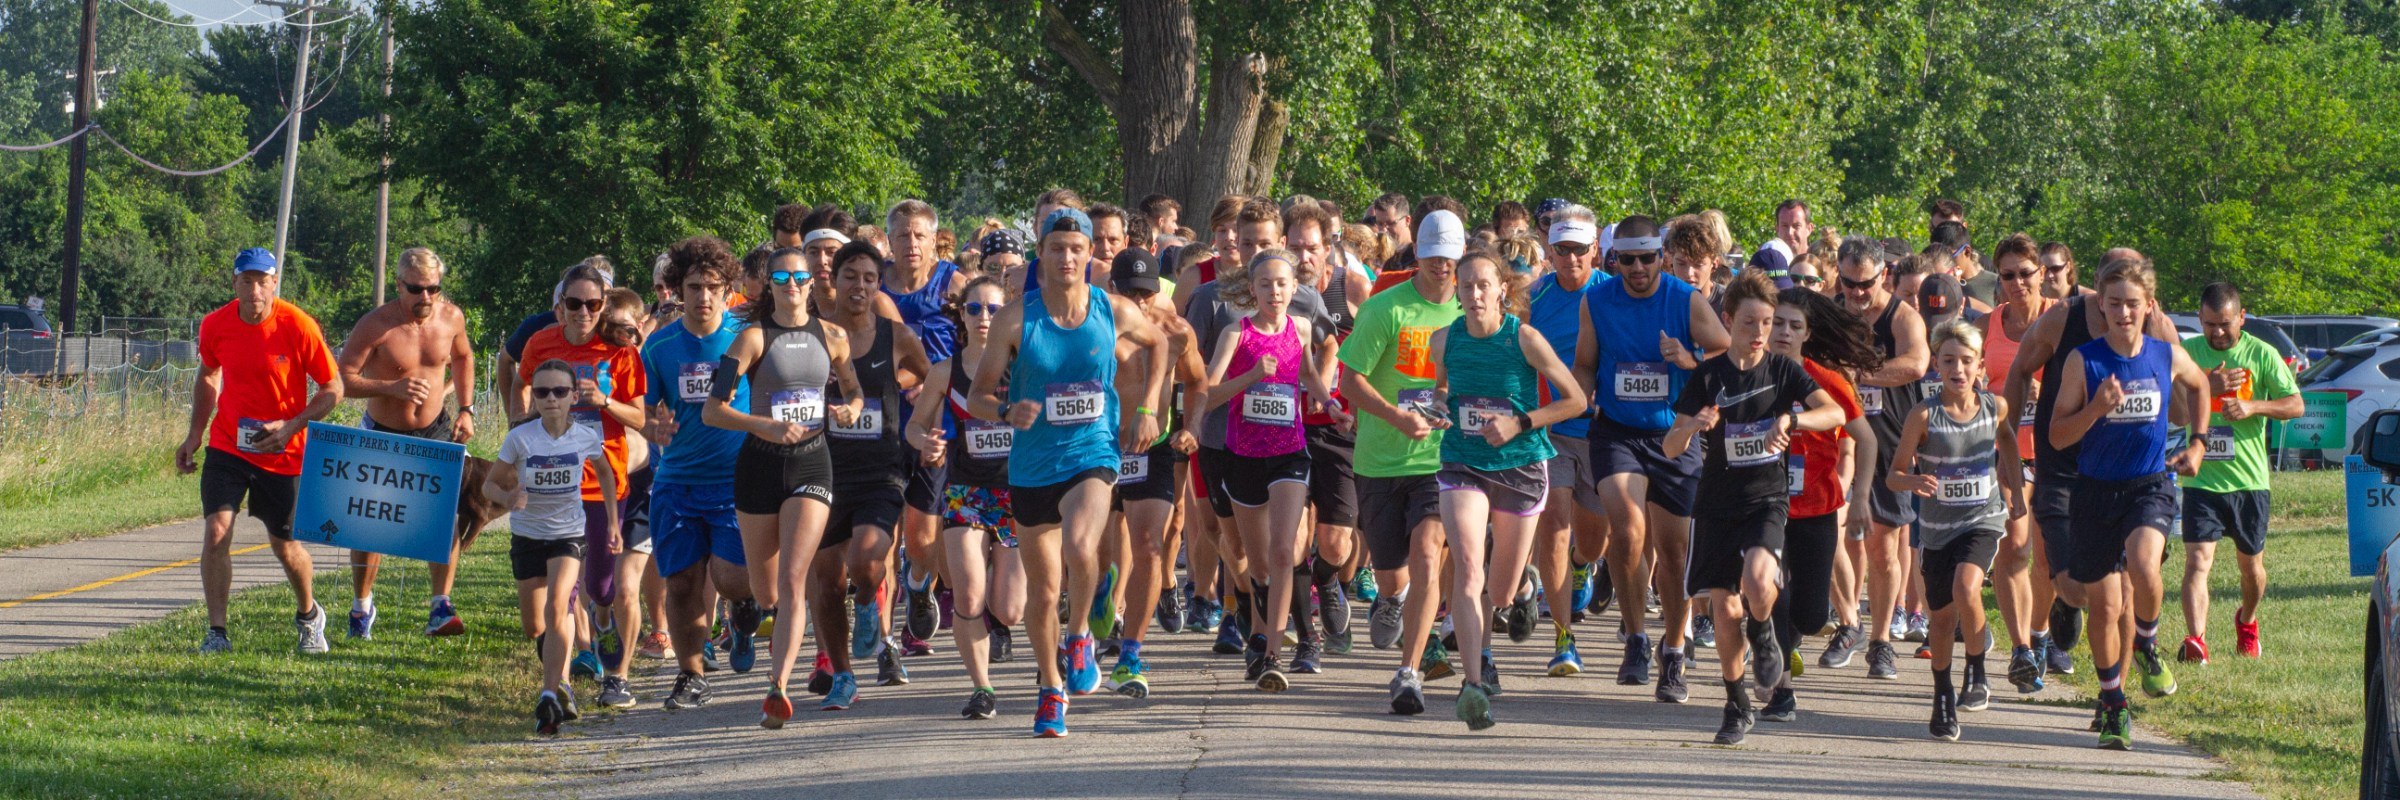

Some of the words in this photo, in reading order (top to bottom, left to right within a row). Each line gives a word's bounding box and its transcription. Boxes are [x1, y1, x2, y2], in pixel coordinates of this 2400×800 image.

[686, 378, 712, 394] 542
[1623, 377, 1659, 393] 5484
[781, 405, 815, 423] 5467
[1056, 397, 1095, 416] 5564
[1252, 398, 1287, 416] 5585
[311, 427, 355, 446] McHENRY
[359, 437, 389, 451] PARKS
[393, 442, 400, 454] &
[404, 444, 462, 463] RECREATION
[974, 432, 1012, 450] 5459
[1734, 438, 1764, 457] 550
[321, 458, 350, 481] 5K
[356, 463, 442, 494] STARTS
[534, 469, 571, 486] 5436
[1943, 480, 1980, 498] 5501
[2366, 488, 2396, 508] 5K
[347, 496, 407, 523] HERE
